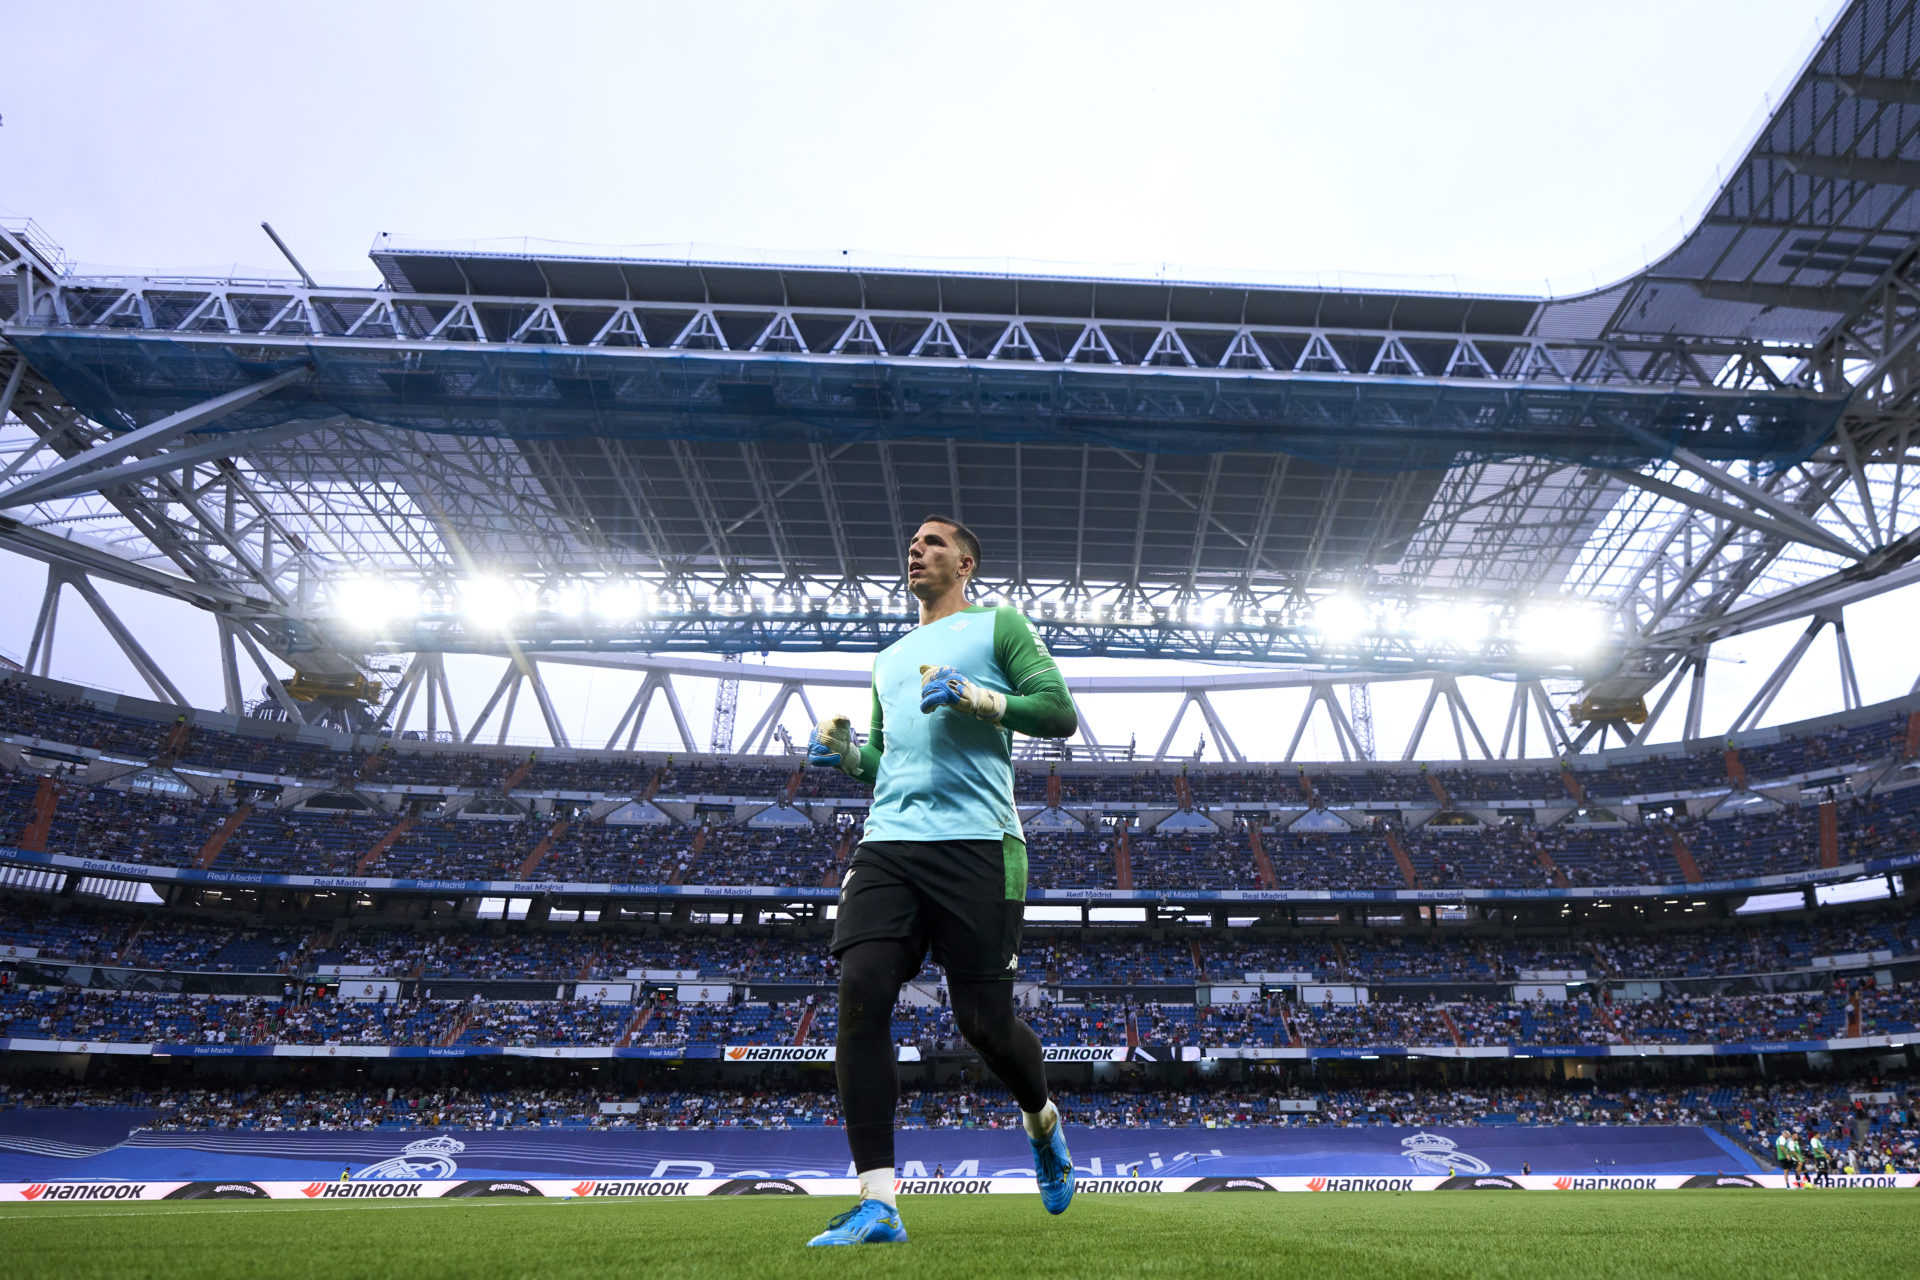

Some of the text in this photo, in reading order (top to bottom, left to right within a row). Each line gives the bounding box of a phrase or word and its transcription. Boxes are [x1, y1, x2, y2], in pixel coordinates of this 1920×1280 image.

[83, 860, 148, 875] Real Madrid
[207, 872, 262, 883] Real Madrid
[1785, 873, 1805, 884] Real
[314, 878, 367, 888] Real Madrid
[417, 880, 466, 889] Real Madrid
[514, 883, 532, 892] Real
[611, 885, 658, 894] Real Madrid
[704, 887, 752, 896] Real Madrid
[797, 887, 814, 896] Real
[1173, 890, 1198, 898] Madrid
[1331, 890, 1346, 898] Real
[1066, 891, 1112, 899] Real Madrid
[1242, 892, 1287, 900] Real Madrid
[1418, 891, 1433, 899] Real
[194, 1046, 234, 1054] Real Madrid
[428, 1048, 465, 1056] Real Madrid
[648, 1049, 684, 1057] Real Madr
[746, 1048, 829, 1060] HANKOOK
[900, 1180, 992, 1194] HANKOOK
[1074, 1180, 1163, 1193] HANKOOK
[1326, 1179, 1413, 1192] HANKOOK
[1573, 1177, 1657, 1190] HANKOOK
[42, 1185, 146, 1199] HANKOOK
[323, 1184, 422, 1198] HANKOOK
[593, 1182, 689, 1196] HANKOOK
